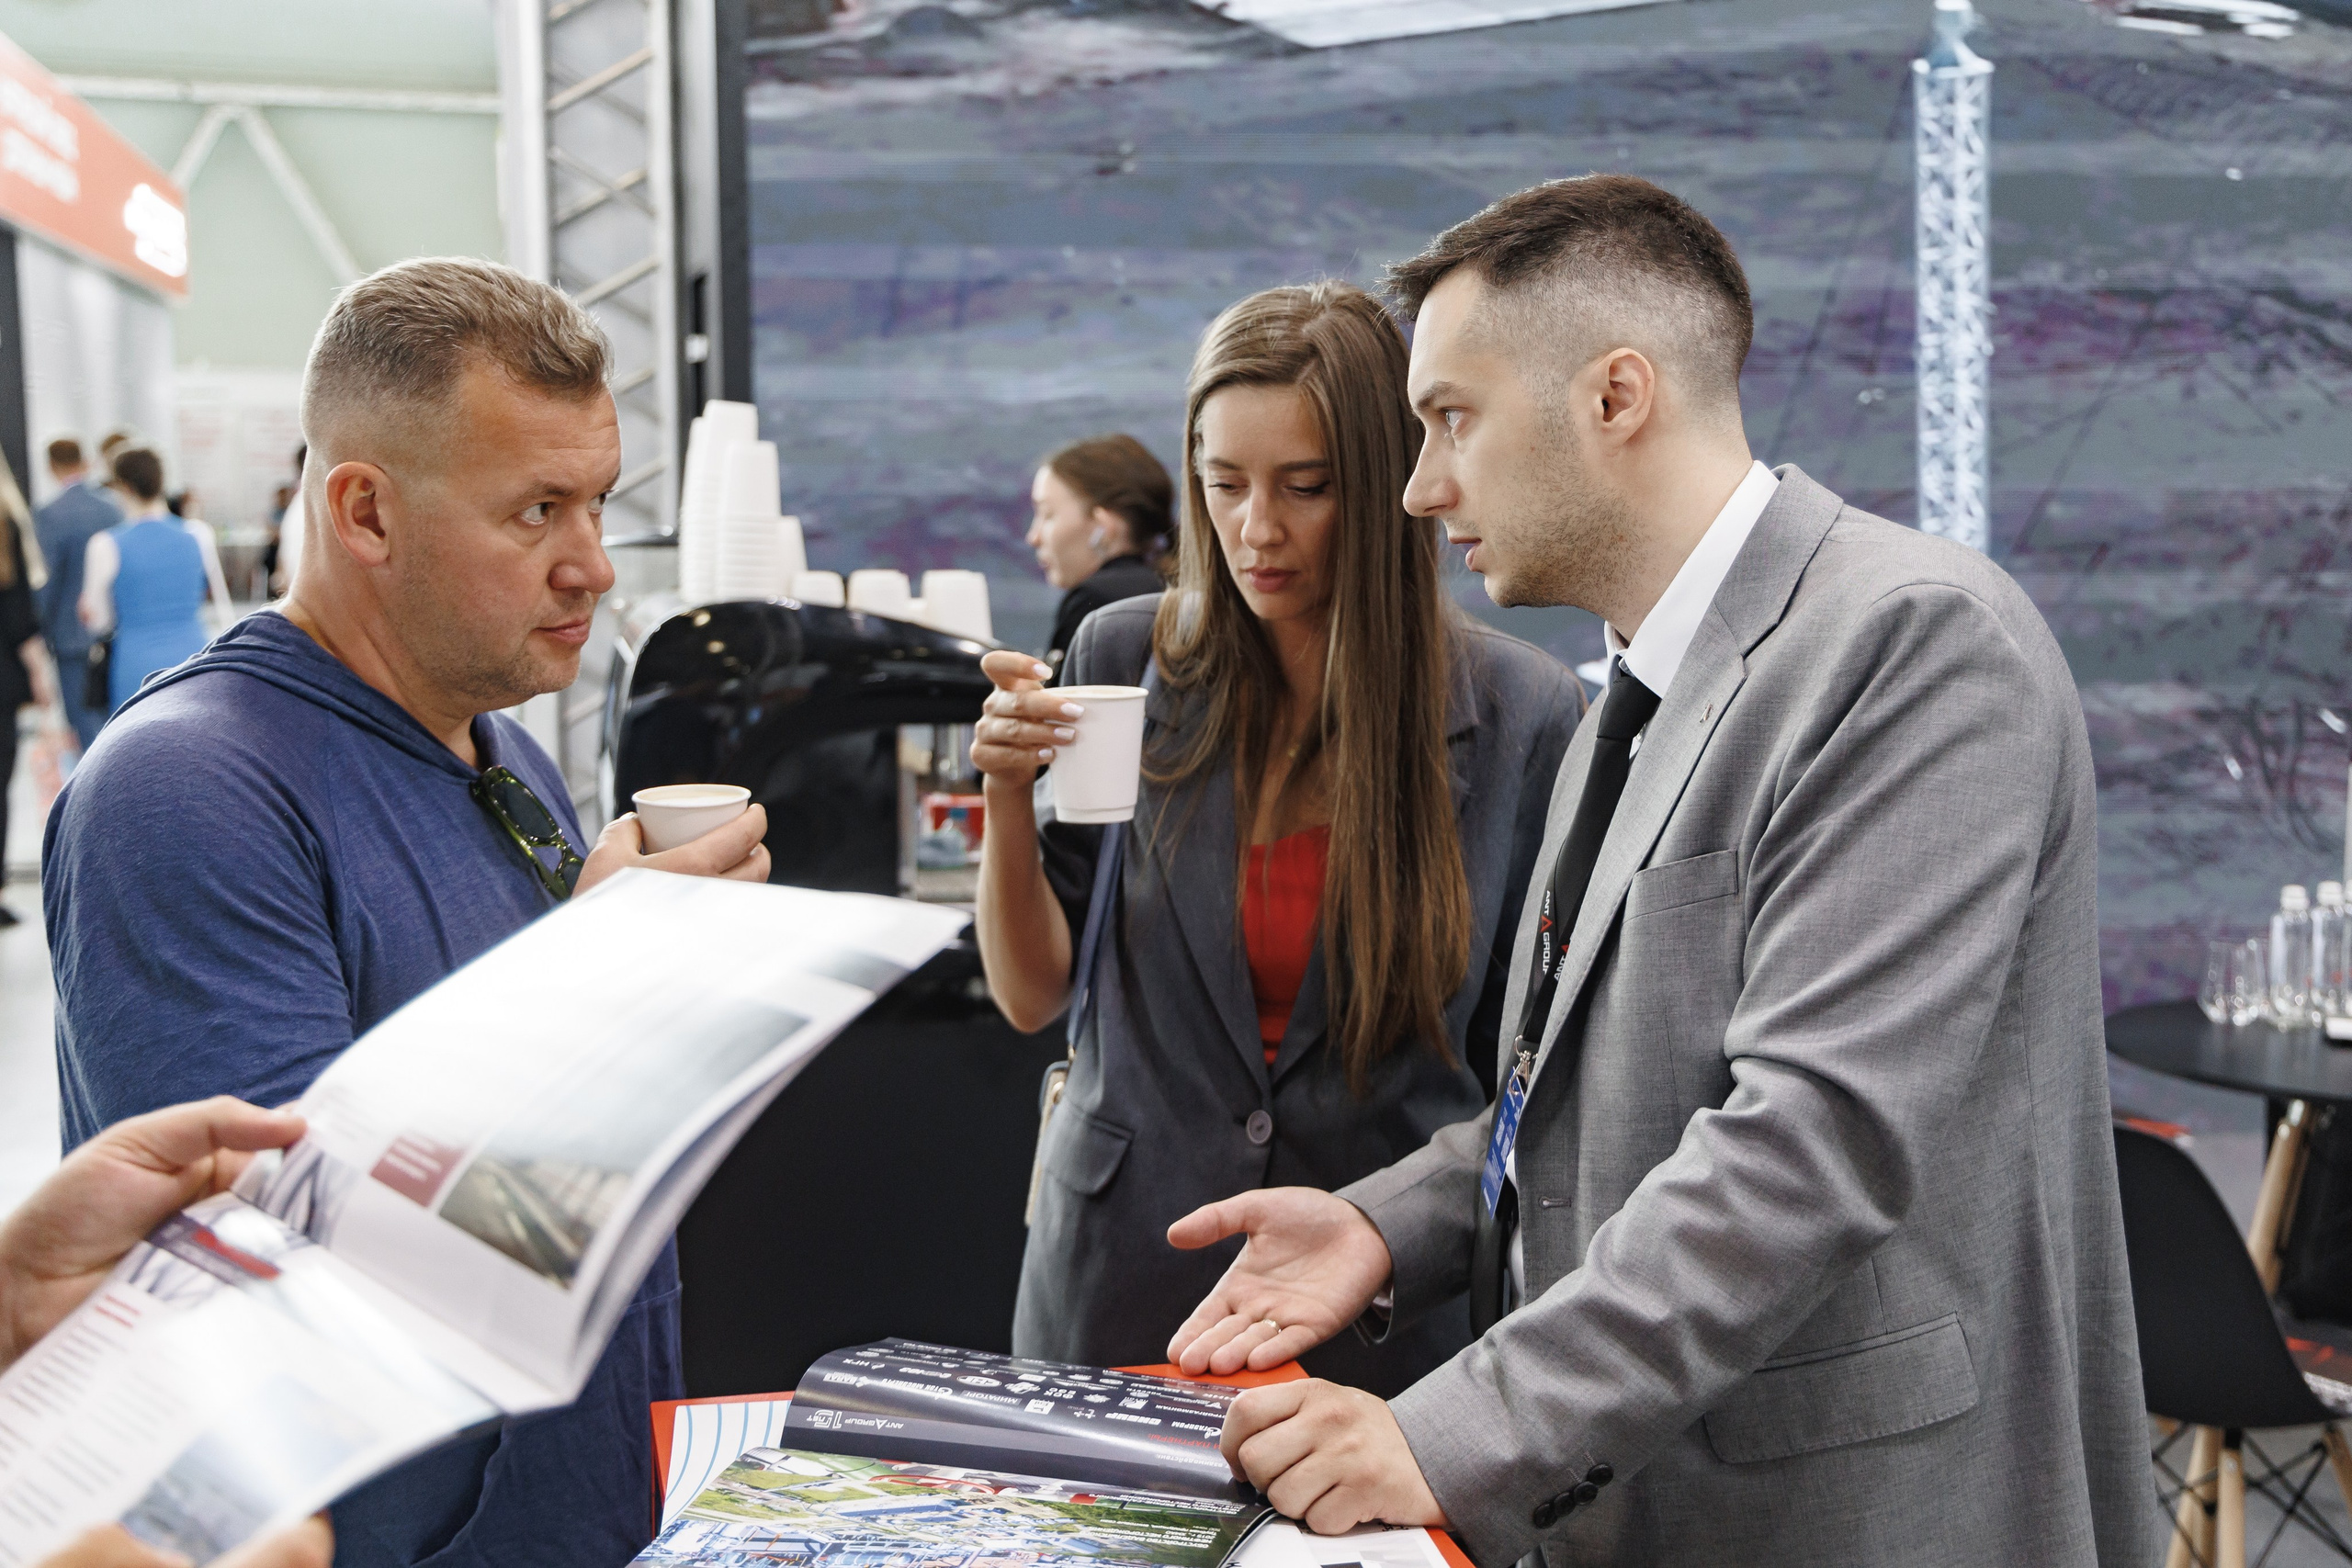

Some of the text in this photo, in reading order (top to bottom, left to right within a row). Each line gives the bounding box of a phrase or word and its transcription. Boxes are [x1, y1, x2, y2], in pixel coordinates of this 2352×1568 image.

[964, 1392, 1018, 1404] МИРАТОРГ
[1155, 1404, 1227, 1418] ТРОЙГАЗМОНТАЖ
[844, 1418, 876, 1427] GROUP
[1146, 1538, 1209, 1549] ОБУСТРОЙСТВО
[1162, 1534, 1213, 1544] НЕФТЯНОГО
